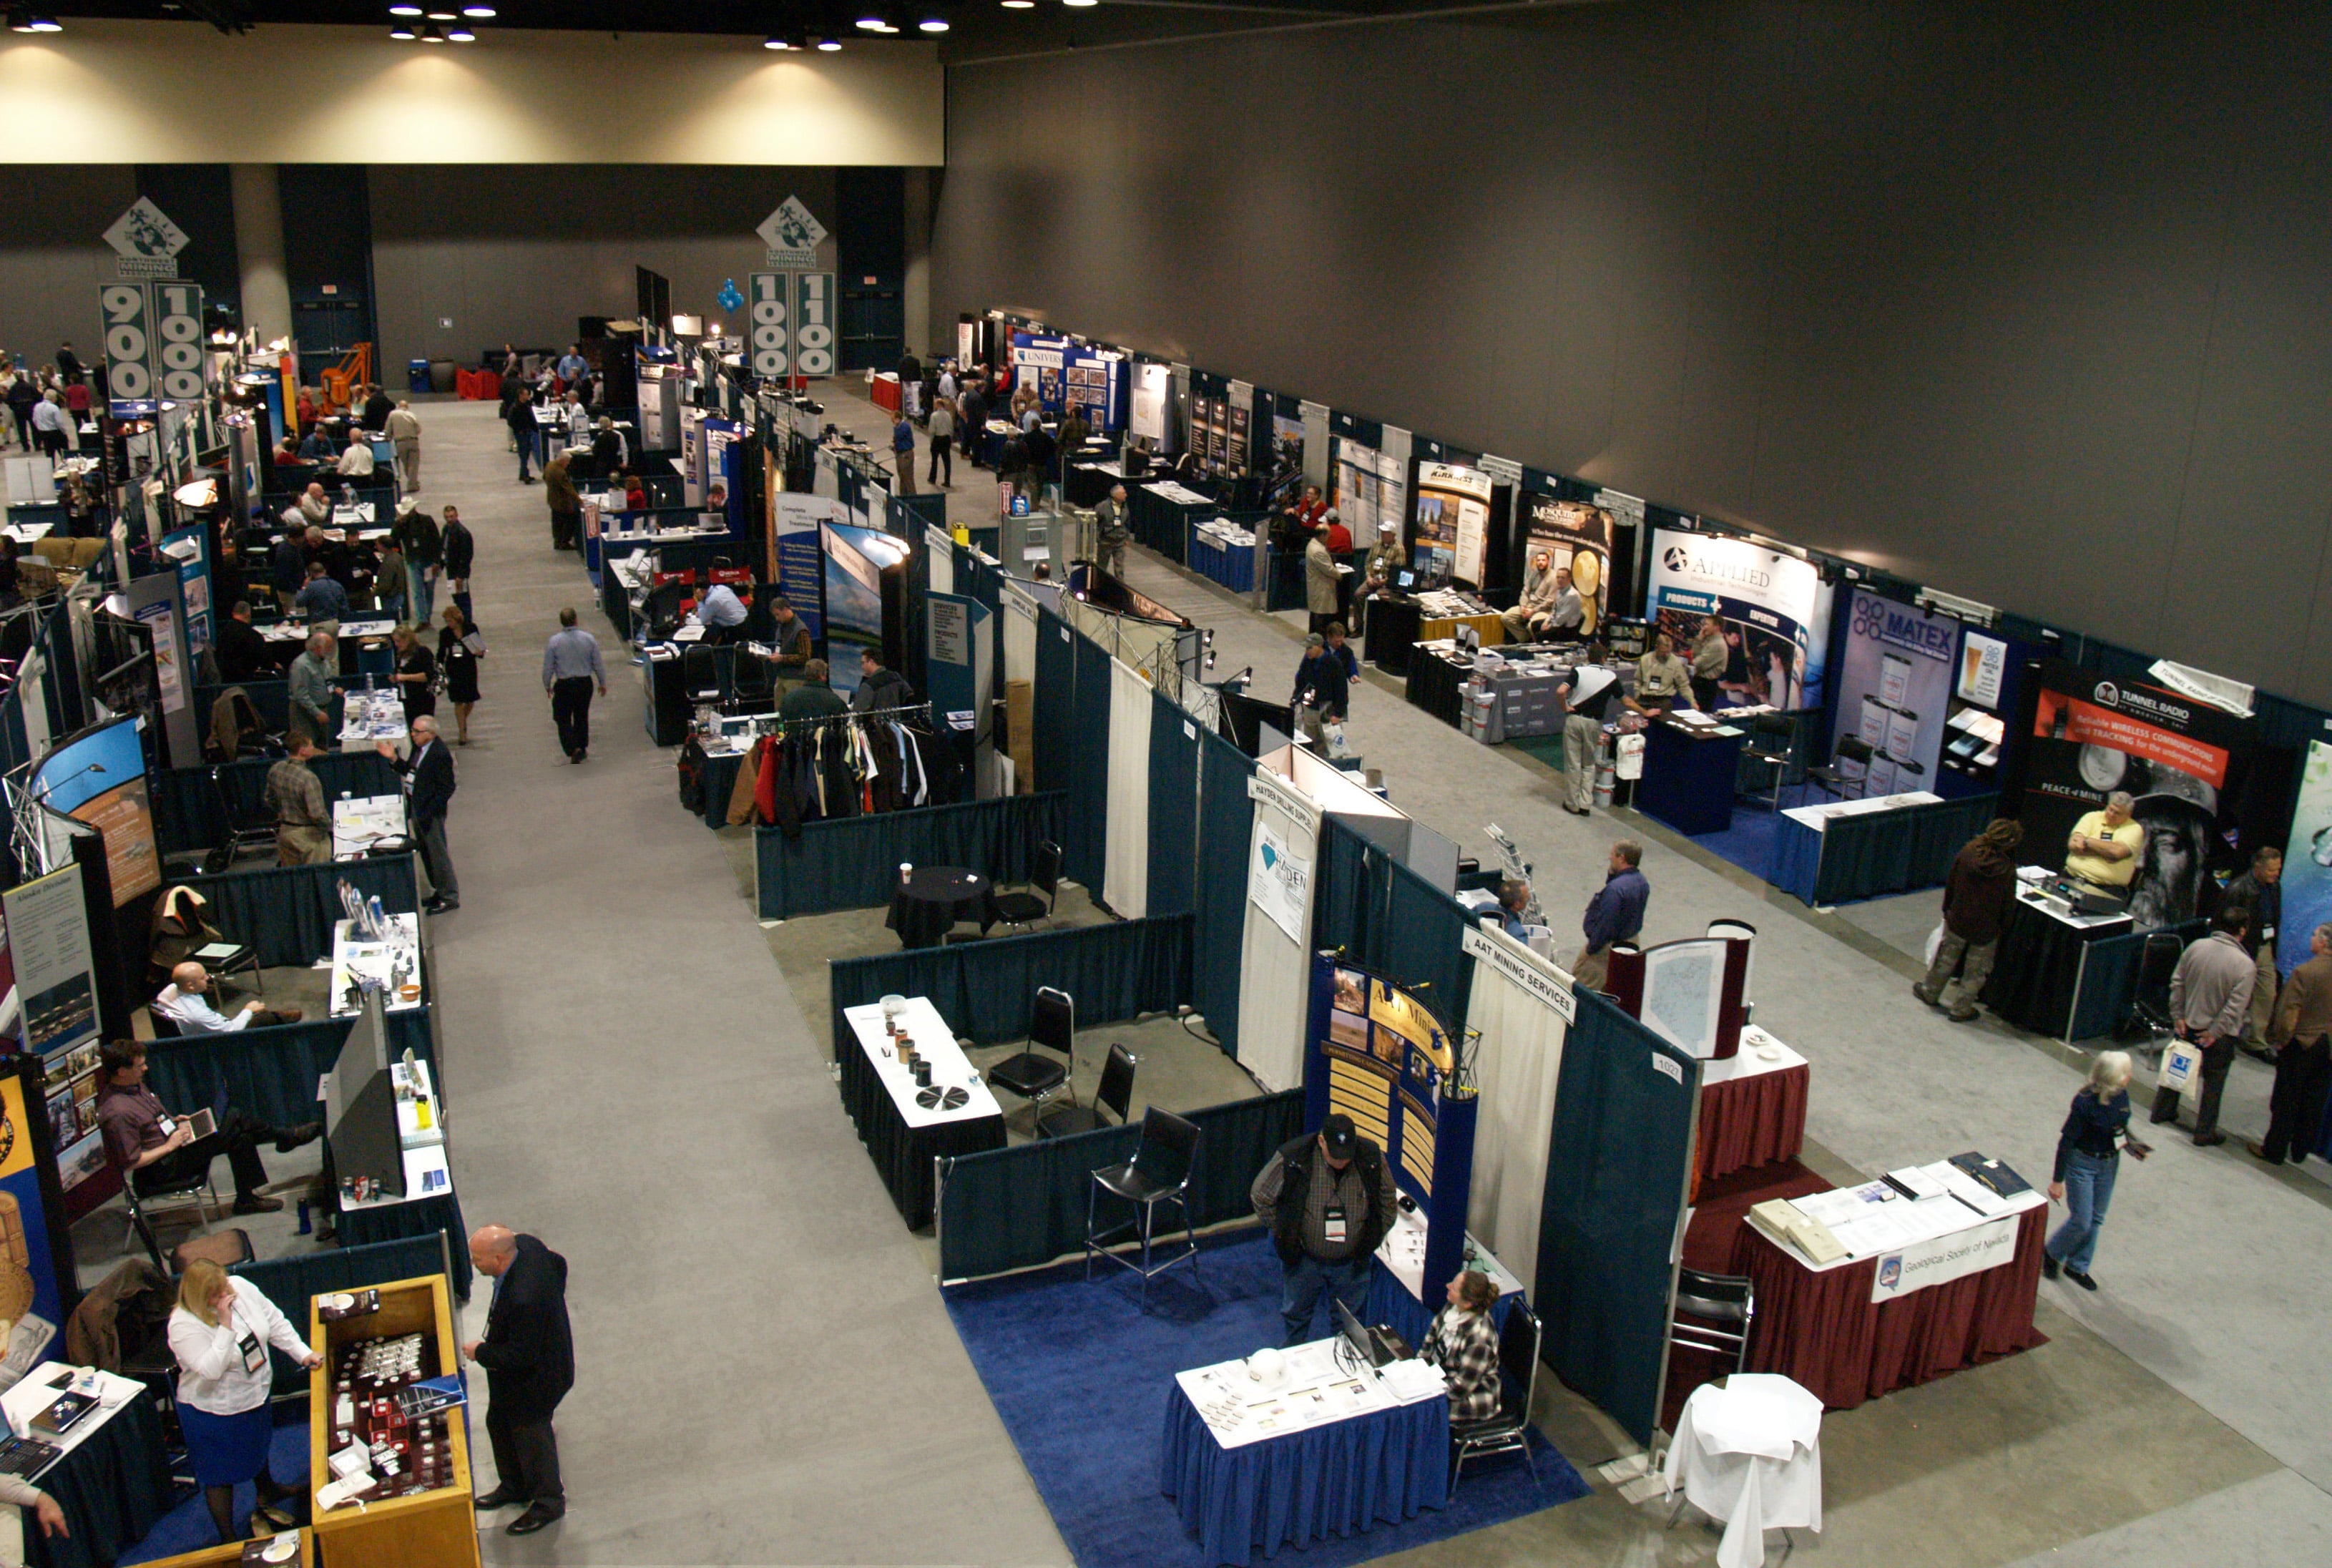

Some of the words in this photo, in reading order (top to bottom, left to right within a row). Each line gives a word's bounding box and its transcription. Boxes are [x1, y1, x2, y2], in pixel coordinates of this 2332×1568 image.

[753, 275, 787, 374] 1000
[798, 275, 831, 373] 1100
[102, 286, 150, 398] 900
[161, 288, 202, 398] 1000
[1691, 558, 1770, 588] APPLIED
[1666, 592, 1708, 608] PRODUCTS
[1749, 609, 1778, 628] EXPERTISE
[1887, 612, 1951, 651] MATEX
[2122, 690, 2158, 710] TUNNEL
[2159, 702, 2190, 720] RADIO
[2092, 727, 2135, 745] TRACKING
[2137, 739, 2149, 749] for
[2149, 743, 2162, 753] the
[2112, 721, 2150, 739] WIRELESS
[2152, 732, 2214, 763] COMMUNICATIONS
[1256, 784, 1276, 802] HAYDEN
[2042, 783, 2072, 795] PEACE
[2079, 790, 2104, 802] MINE
[1474, 939, 1493, 956] AAT
[1494, 950, 1526, 979] MINING
[1527, 974, 1570, 1012] SERVICES
[1659, 1059, 1679, 1077] 1027
[1904, 1253, 1946, 1274] Geological
[1946, 1246, 1972, 1262] Society
[1972, 1240, 1983, 1253] of
[1983, 1233, 2010, 1251] Nevada
